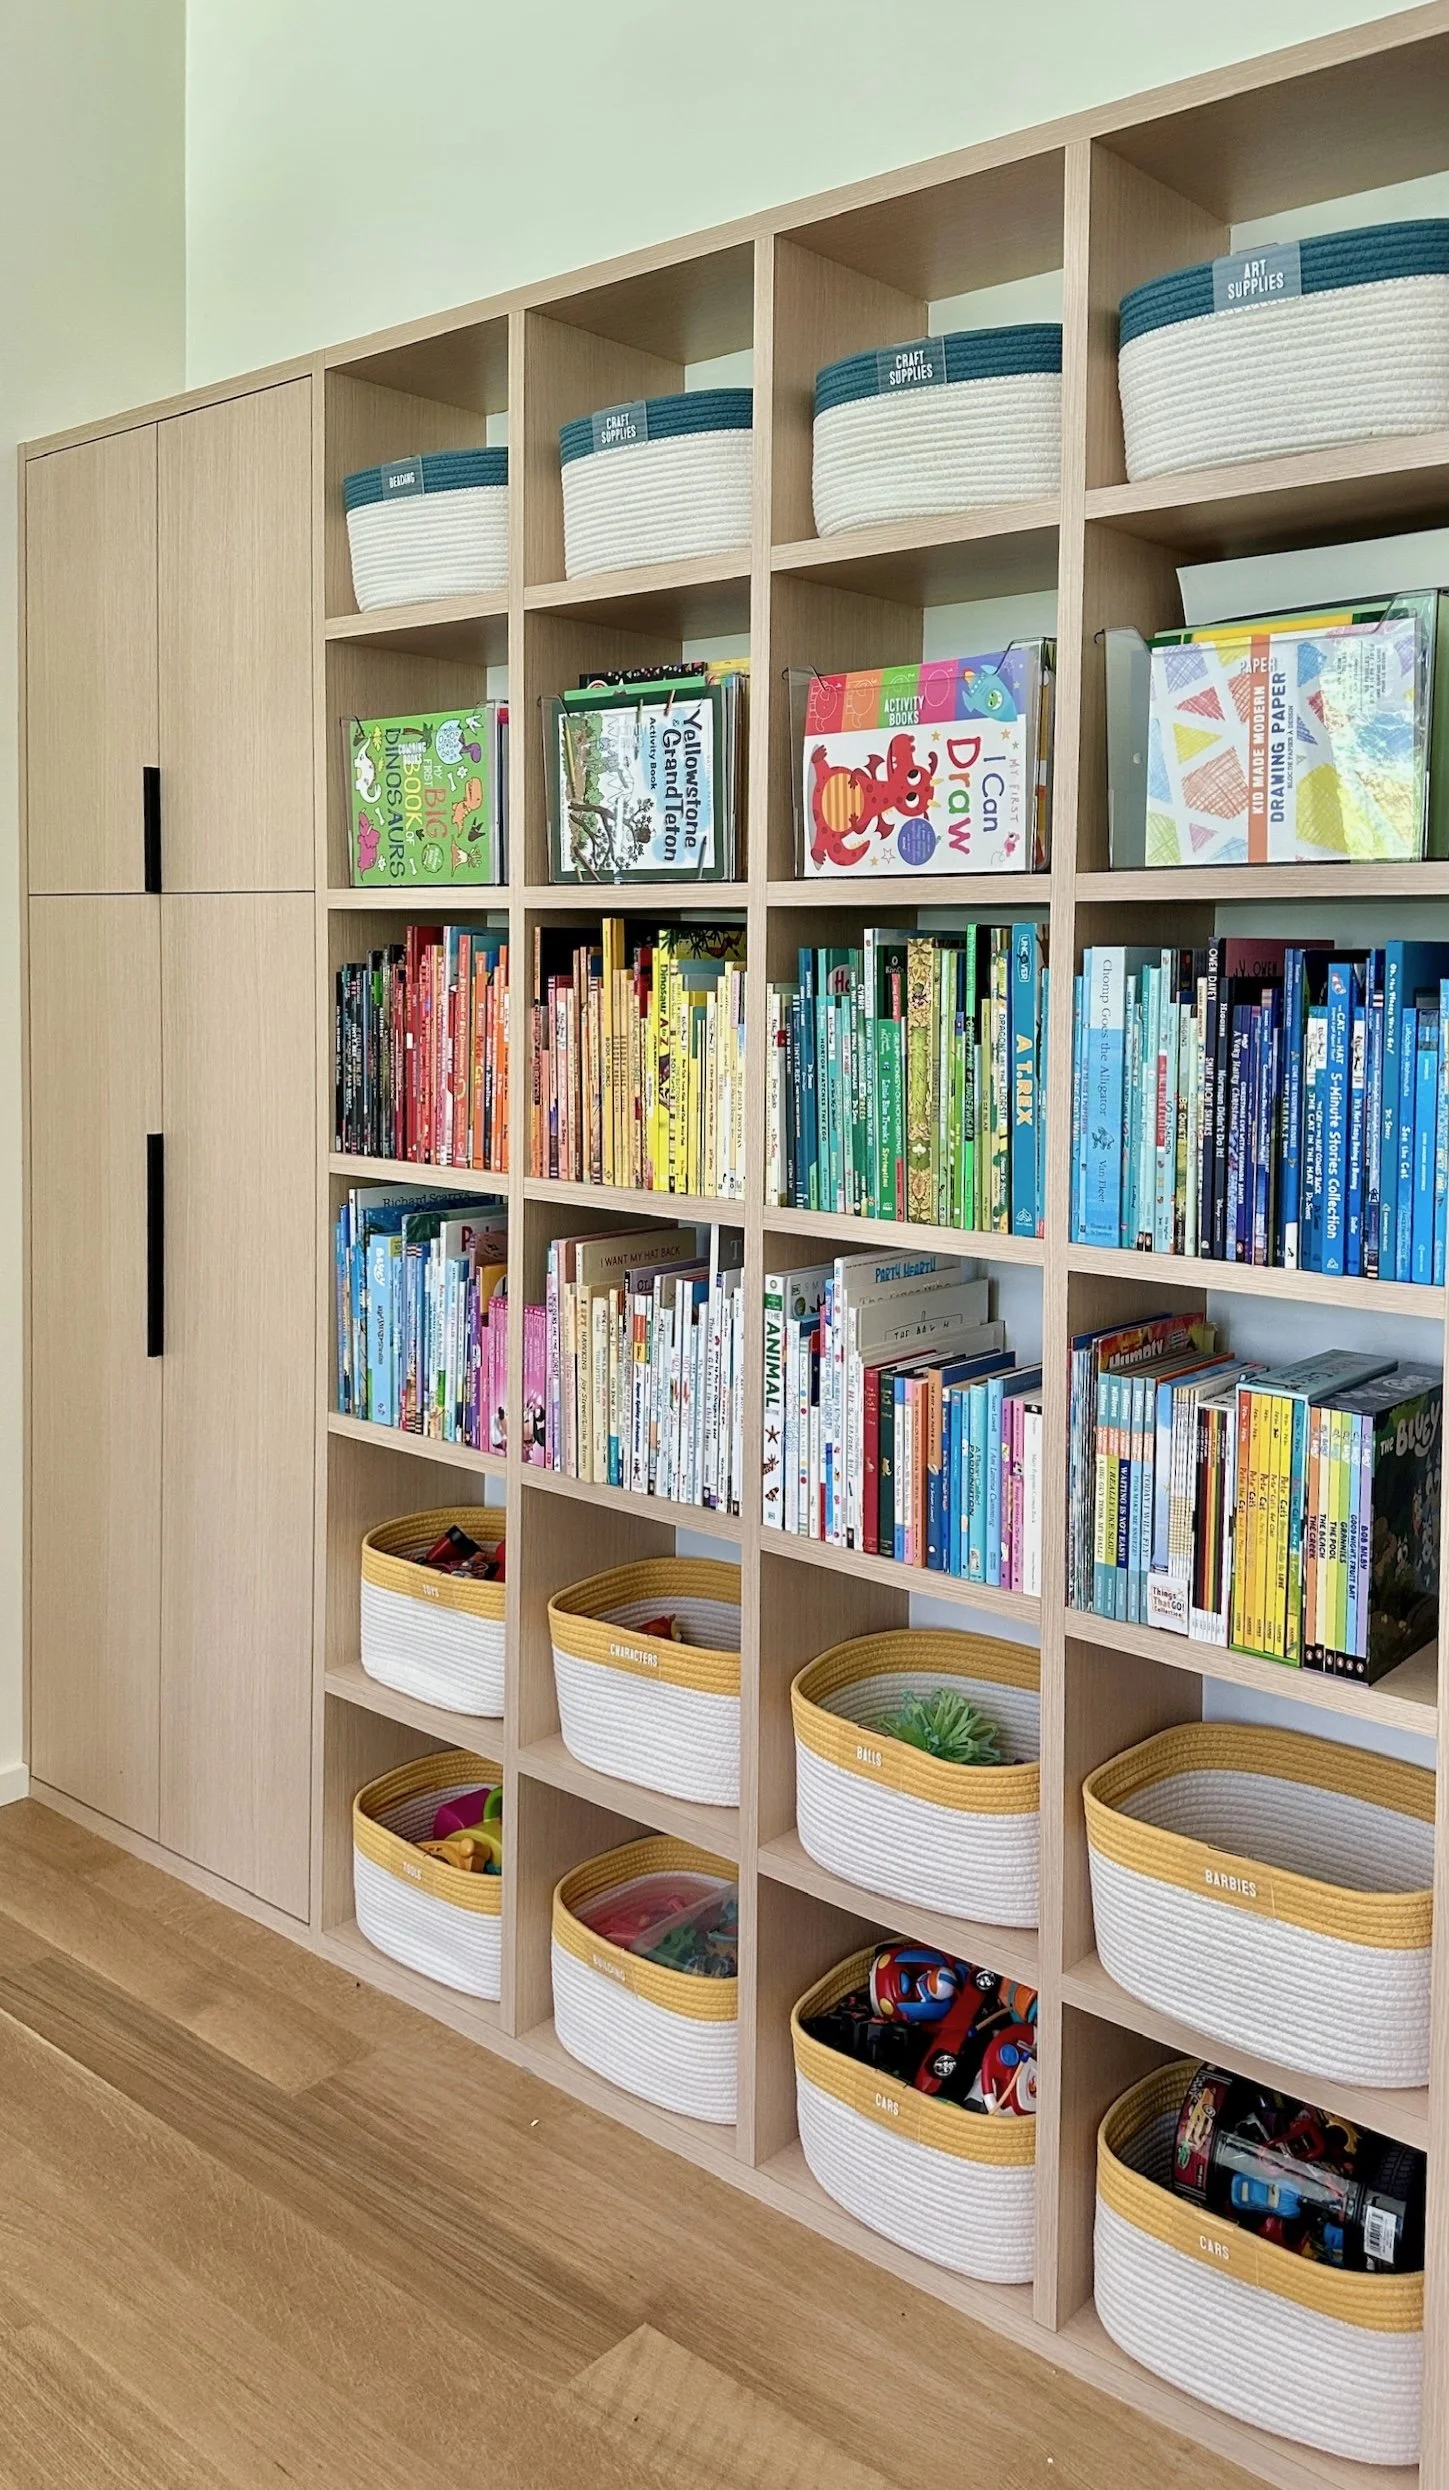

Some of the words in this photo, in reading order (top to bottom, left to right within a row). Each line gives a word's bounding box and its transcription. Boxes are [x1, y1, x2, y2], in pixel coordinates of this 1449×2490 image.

[1244, 260, 1266, 279] ART
[1228, 272, 1284, 300] SUPPLIES
[896, 350, 924, 369] CRAFT
[890, 364, 932, 385] SUPPLIES
[606, 413, 629, 430] CRAFT
[602, 425, 636, 444] SUPPLIES
[1240, 657, 1277, 673] PAPER
[884, 696, 924, 712] ACTIVITY
[1272, 672, 1286, 733] PAPER
[889, 710, 920, 726] BOOKS
[1254, 686, 1265, 744] MODERN
[649, 718, 658, 760] Activity
[433, 766, 442, 778] MY
[663, 730, 683, 798] Grand
[1009, 758, 1018, 776] MY
[1253, 749, 1264, 788] MADE
[650, 763, 658, 790] Book
[684, 710, 702, 848] Yellowstone
[1270, 742, 1285, 822] DRAWING
[386, 728, 405, 878] DINOSAURS
[404, 758, 422, 829] BOOK
[947, 736, 981, 854] Draw
[982, 773, 1004, 832] Can
[1009, 784, 1018, 823] FIRST
[1252, 792, 1264, 814] KID
[424, 788, 448, 838] BIG
[406, 831, 414, 846] OF
[664, 798, 684, 862] Teton
[1020, 936, 1029, 982] UNCOVER
[1207, 948, 1218, 972] OWEN
[660, 964, 669, 1014] Dinosaur
[1100, 960, 1112, 1004] Chomp
[1207, 976, 1218, 1002] DAVEY
[660, 1018, 669, 1028] A
[1101, 1008, 1111, 1038] Goes
[475, 1036, 484, 1060] Pete
[660, 1036, 669, 1046] Z
[1016, 1034, 1032, 1054] A
[1101, 1043, 1110, 1061] the
[475, 1065, 484, 1086] Cat
[1204, 1058, 1213, 1080] SMART
[1016, 1060, 1032, 1126] T.REX
[1098, 1066, 1110, 1116] Alligator
[1204, 1082, 1213, 1106] ABOUT
[1218, 1070, 1226, 1104] Norman
[1307, 1094, 1315, 1110] THE
[1330, 1072, 1342, 1128] 5-Minute
[1204, 1110, 1213, 1136] SHARKS
[1216, 1106, 1226, 1132] Didn't
[1307, 1114, 1315, 1131] CAT
[1216, 1134, 1226, 1145] Do
[1307, 1135, 1315, 1144] IN
[1402, 1126, 1410, 1142] See
[1216, 1148, 1226, 1158] It!
[1307, 1148, 1315, 1162] THE
[1328, 1132, 1342, 1174] Stories
[1402, 1146, 1410, 1159] the
[1098, 1160, 1107, 1178] Van
[1402, 1162, 1410, 1180] Cat
[1098, 1181, 1107, 1203] Fleet
[1327, 1178, 1341, 1239] Collection
[605, 1254, 628, 1266] WANT
[630, 1252, 642, 1262] MY
[644, 1249, 658, 1260] HAT
[660, 1246, 680, 1258] BACK
[876, 1266, 900, 1284] PARTY
[766, 1320, 780, 1408] ANIMAL
[580, 1378, 588, 1390] Joy
[1122, 1388, 1131, 1420] Willems
[1146, 1390, 1154, 1422] Willems
[1380, 1436, 1394, 1456] THE
[1396, 1401, 1440, 1458] BLUEY
[1120, 1466, 1128, 1503] WAITING
[1108, 1510, 1116, 1530] LIKE
[1118, 1506, 1126, 1515] IS
[1118, 1516, 1126, 1534] NOT
[1108, 1531, 1116, 1555] SLOP!
[1118, 1536, 1126, 1562] EASY!
[1340, 1522, 1348, 1564] GRANNIES
[1153, 1586, 1176, 1600] Things
[1154, 1596, 1170, 1608] That
[610, 1644, 658, 1667] CHARACTERS
[857, 1746, 882, 1767] BALLS
[1205, 1869, 1256, 1898] BARBIES
[876, 2093, 899, 2116] CARS
[1200, 2236, 1229, 2260] CARS
